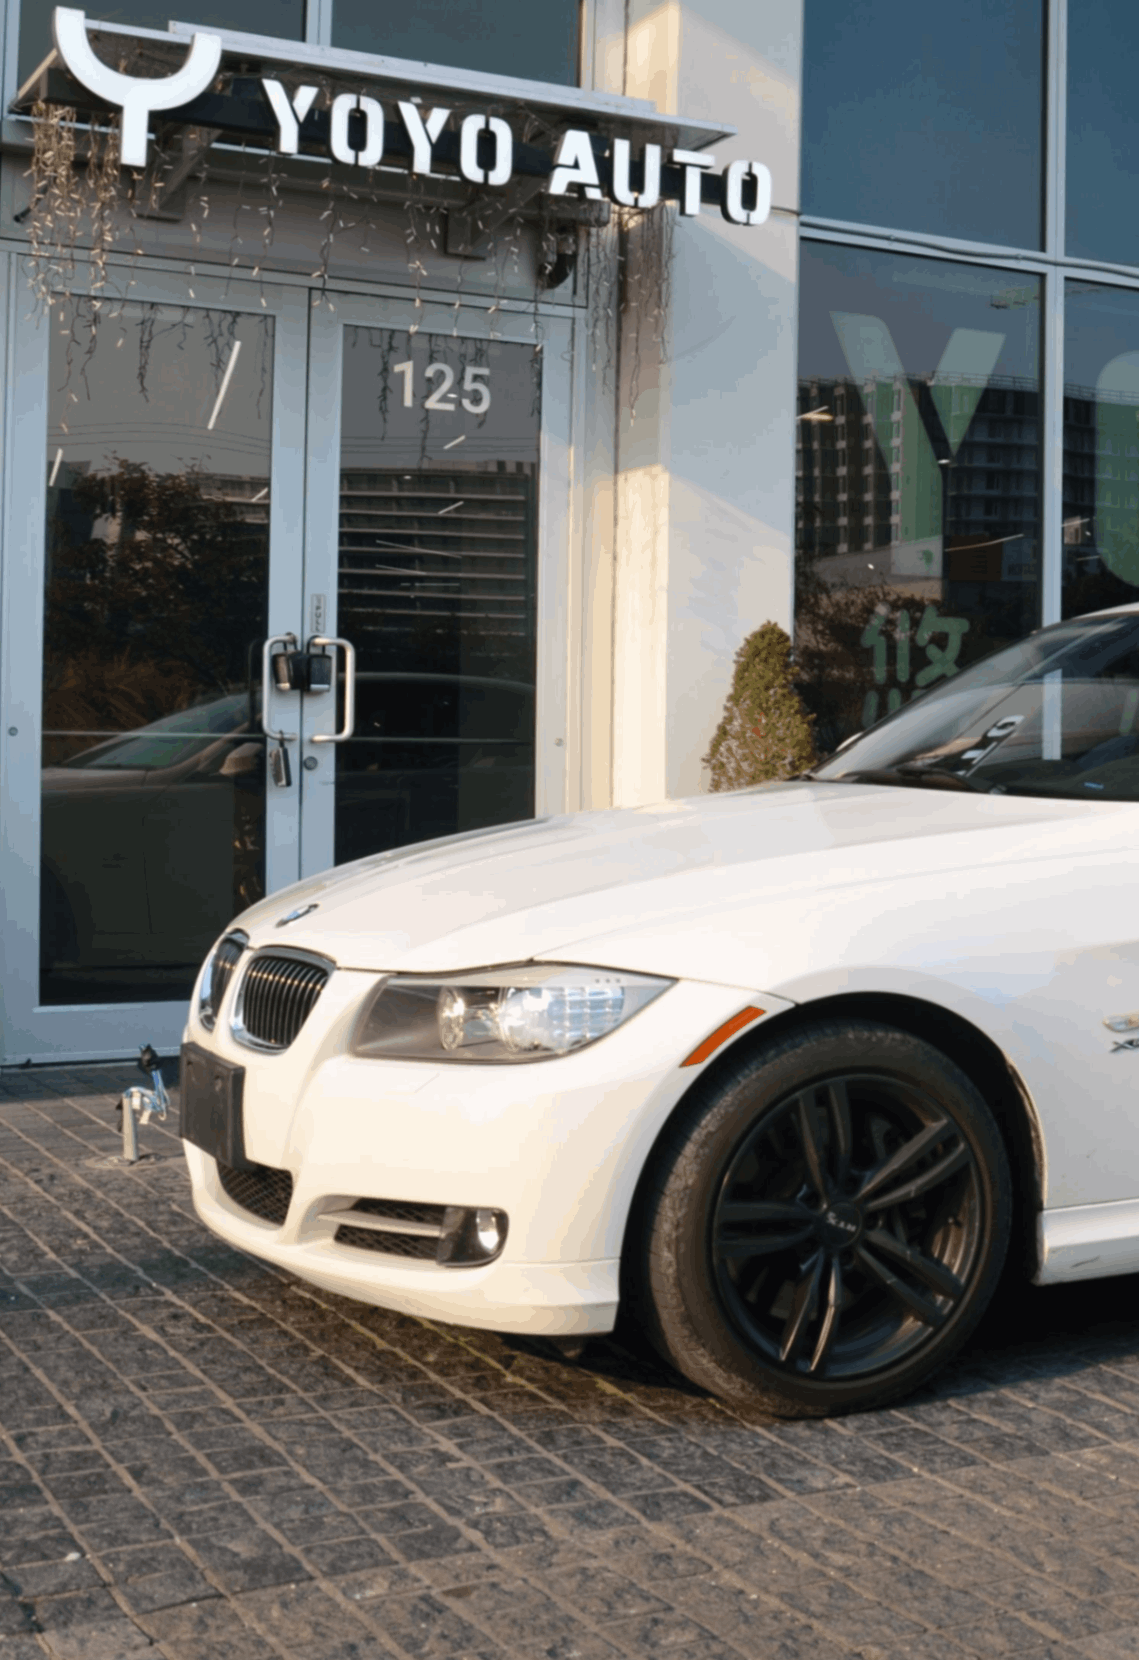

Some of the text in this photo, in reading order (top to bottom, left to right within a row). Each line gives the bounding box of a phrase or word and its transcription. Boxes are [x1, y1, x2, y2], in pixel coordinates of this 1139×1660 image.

[262, 78, 773, 226] YOYO AUTO
[393, 359, 492, 416] 125
